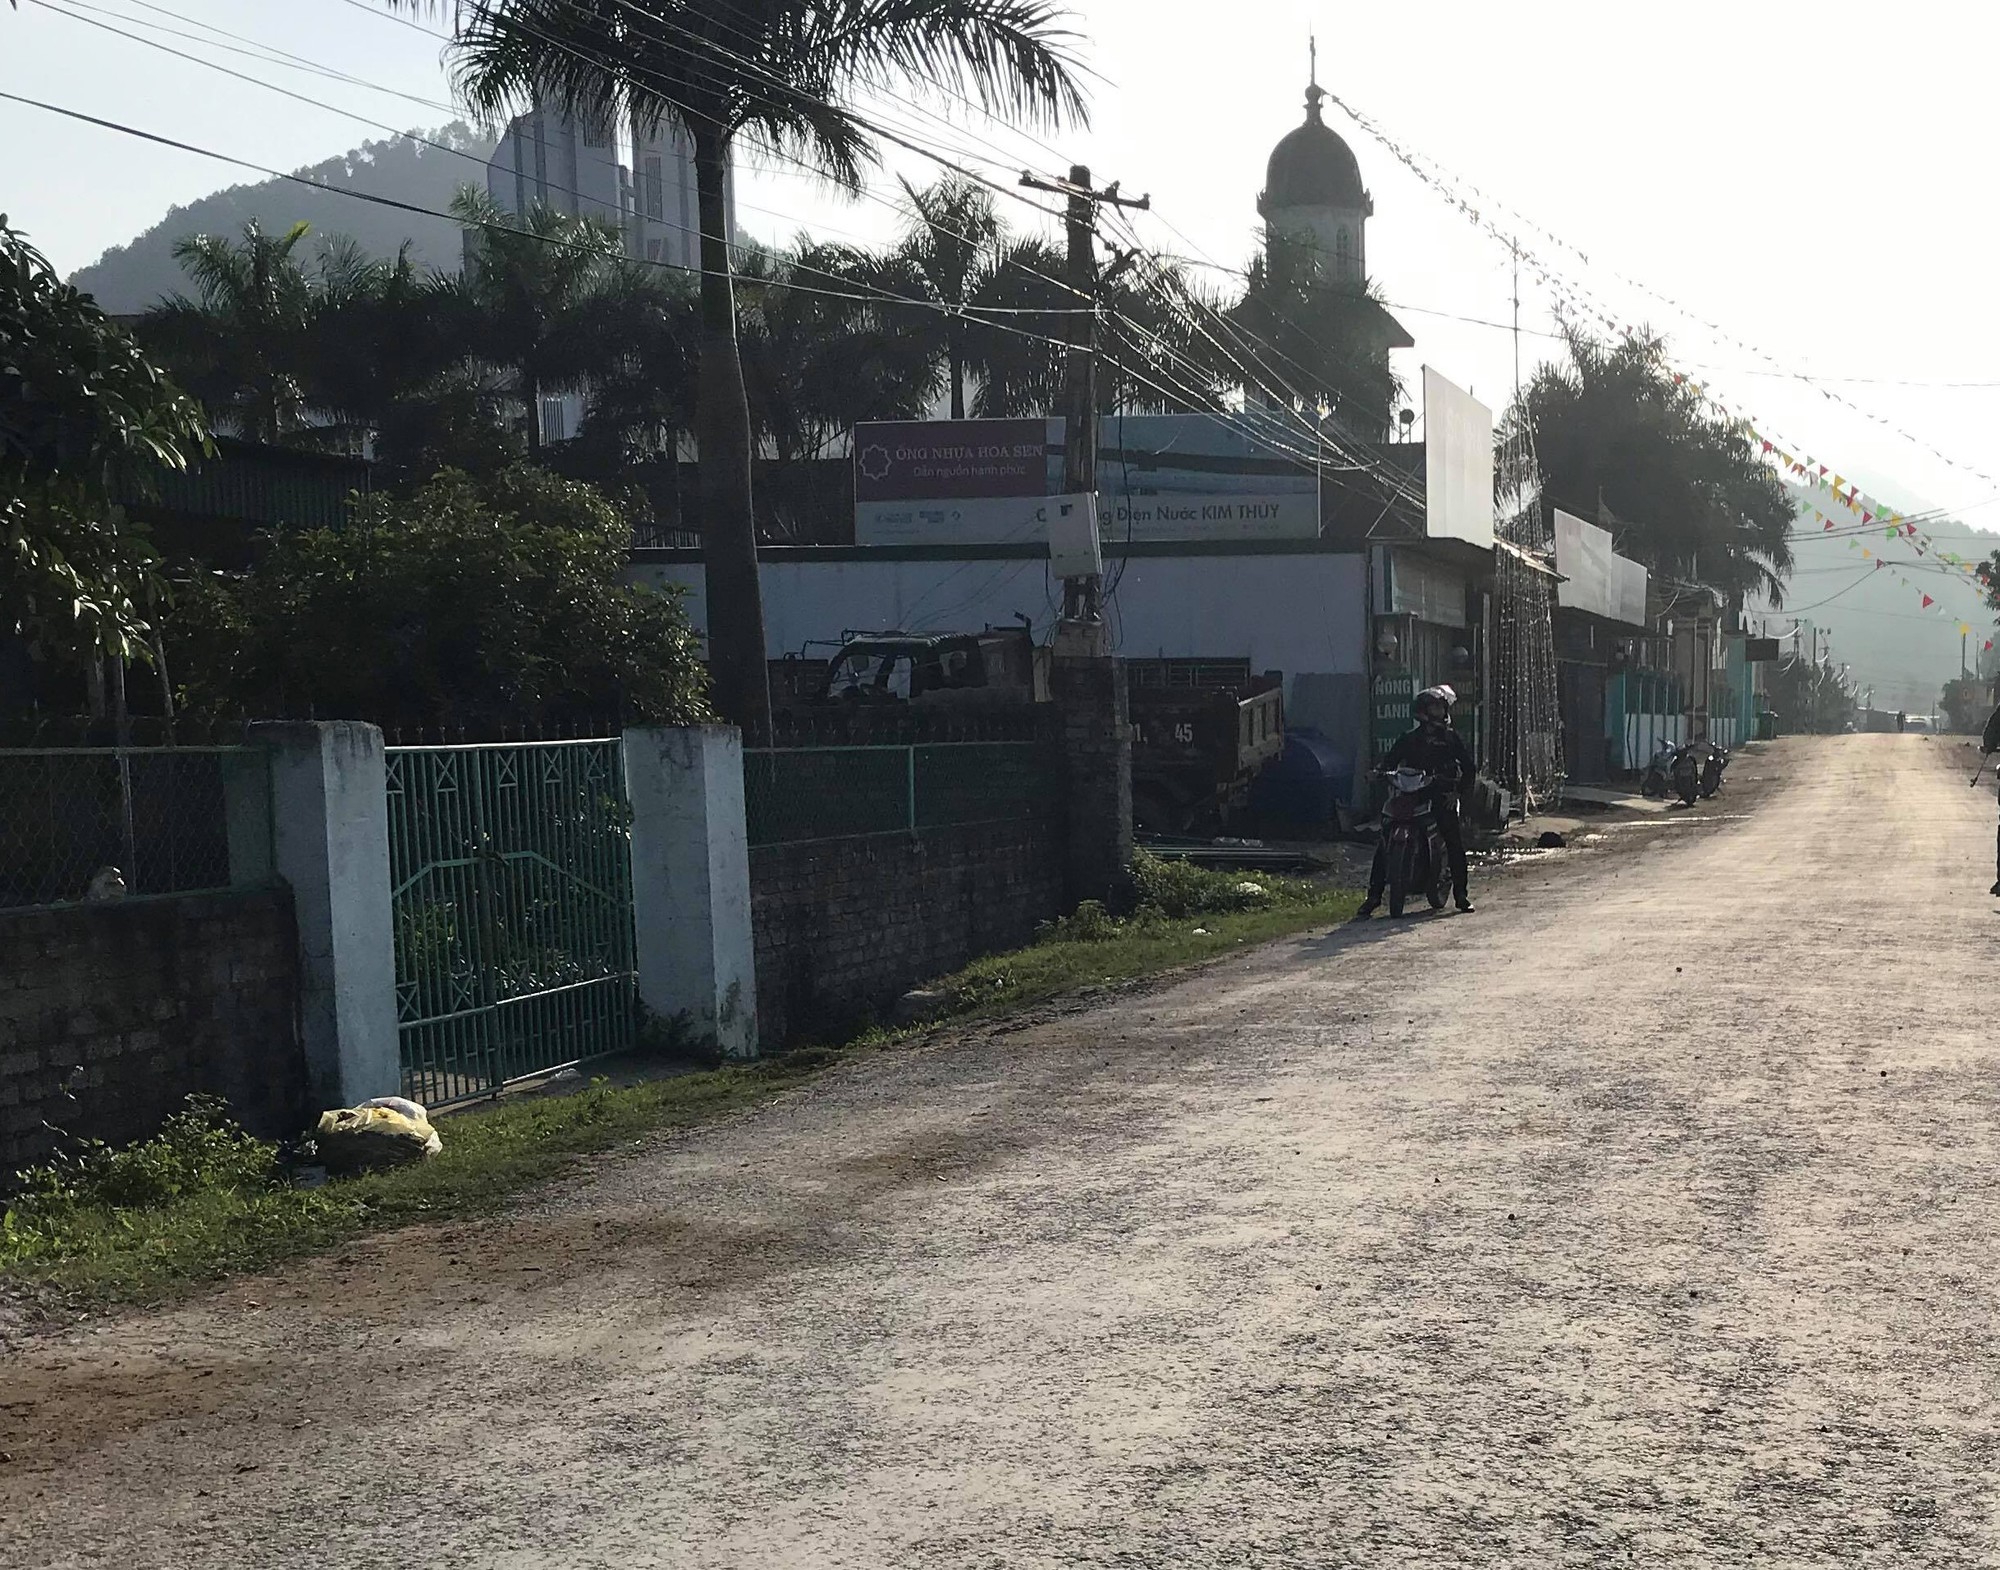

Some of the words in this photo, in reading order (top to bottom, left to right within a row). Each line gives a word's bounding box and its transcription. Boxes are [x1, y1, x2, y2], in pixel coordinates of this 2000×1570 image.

[978, 446, 1010, 458] HOA
[1013, 445, 1043, 457] SEN
[1202, 504, 1232, 520] KIM
[1175, 723, 1193, 743] 45
